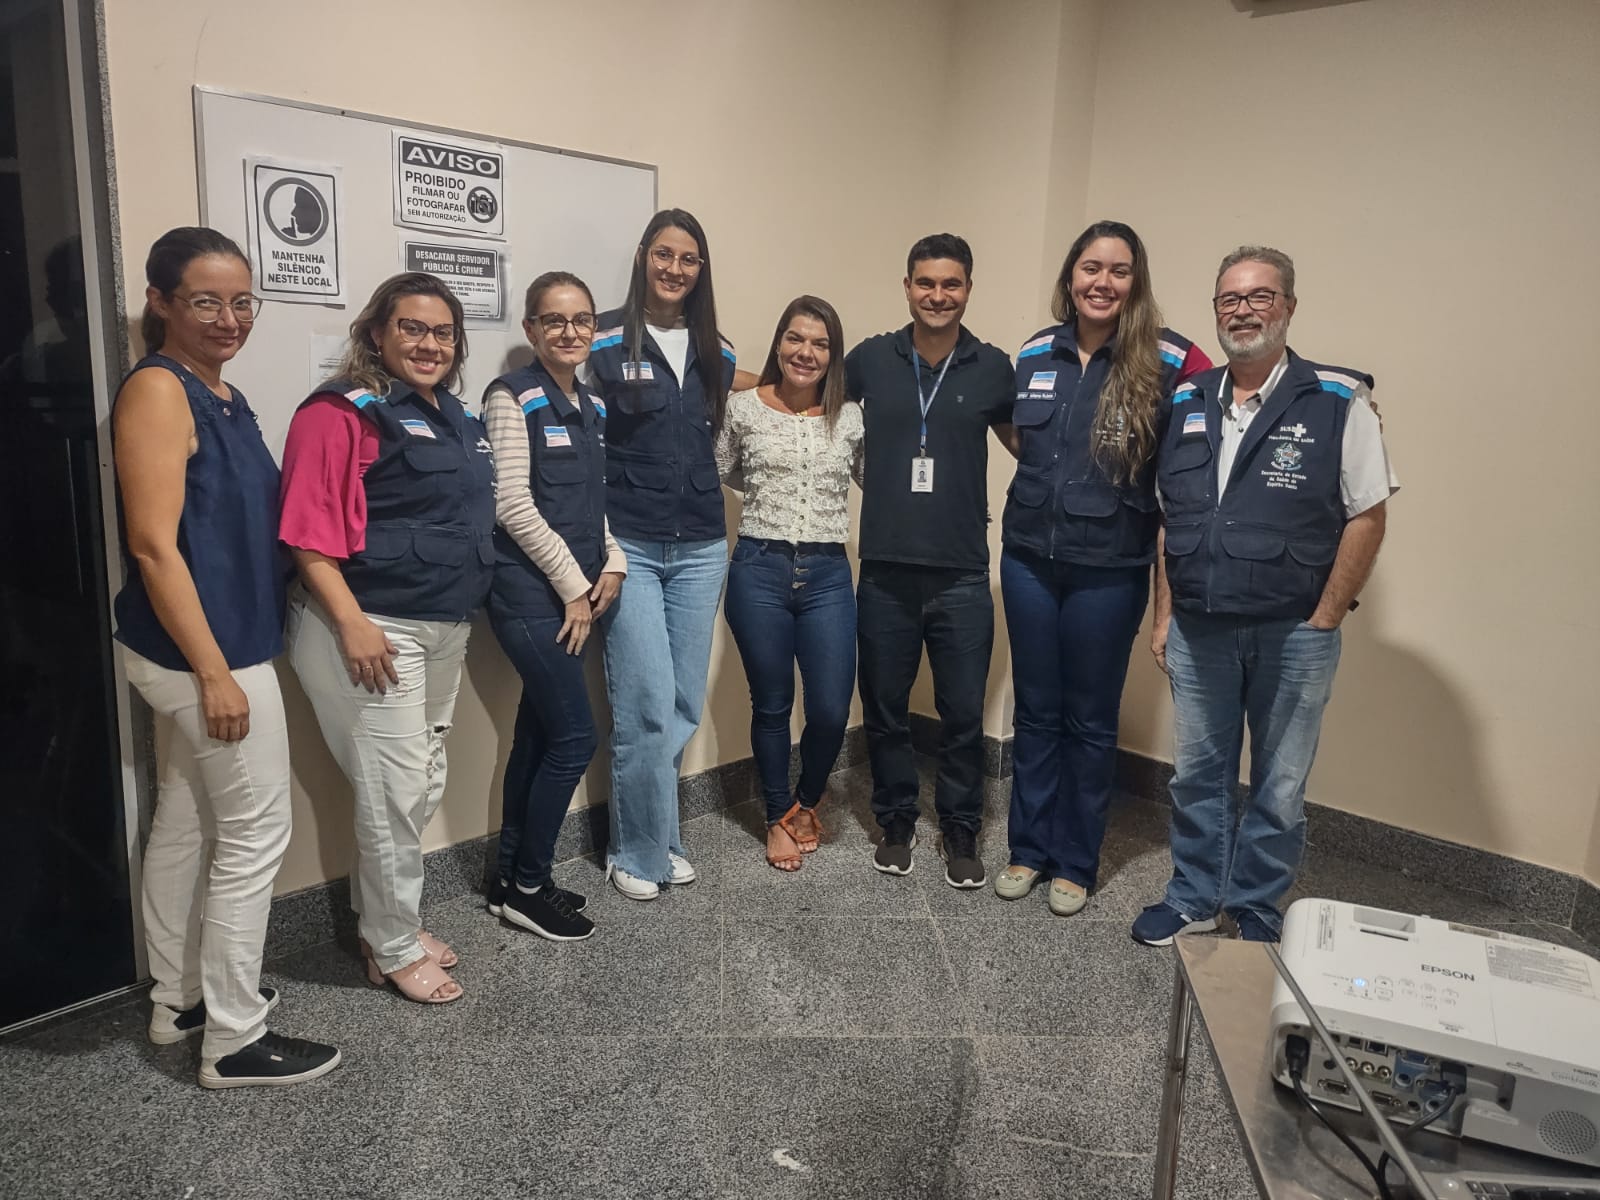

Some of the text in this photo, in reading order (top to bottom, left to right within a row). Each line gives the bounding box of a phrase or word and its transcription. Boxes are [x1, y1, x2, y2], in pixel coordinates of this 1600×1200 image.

[406, 146, 497, 175] AVISO
[405, 171, 466, 190] PROIBIDO
[412, 186, 460, 201] FILMAR OU
[407, 197, 466, 213] FOTOGRAFAR
[422, 211, 466, 222] AUTORIZAÇÃO
[272, 250, 325, 264] MANTENHA
[415, 250, 490, 265] DESACATAR SERVIDOR
[278, 262, 321, 275] SILÊNCIO
[423, 261, 484, 275] PÚBLICO É CRIME
[268, 273, 332, 287] NESTE LOCAL
[1421, 964, 1475, 981] EPSON
